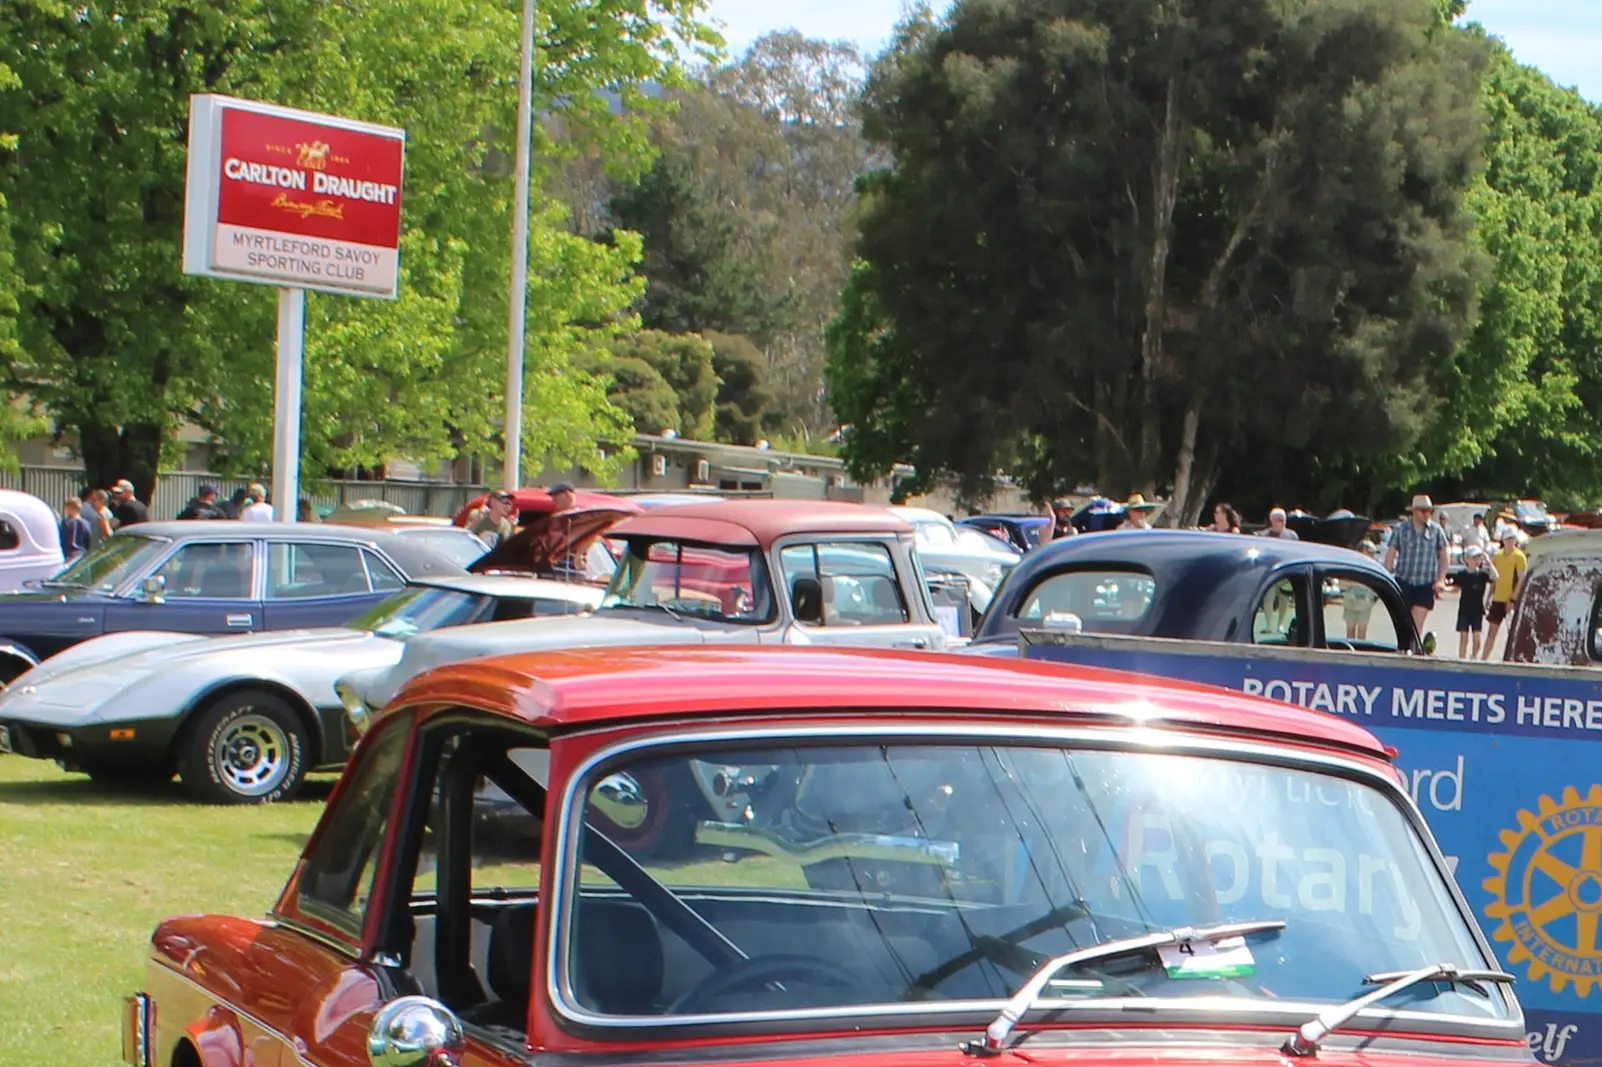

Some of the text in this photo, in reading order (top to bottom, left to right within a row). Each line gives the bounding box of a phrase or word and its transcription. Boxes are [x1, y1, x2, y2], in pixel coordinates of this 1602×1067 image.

[225, 157, 397, 205] CARLTON DRAUGHT
[233, 232, 381, 266] MYRTLEFORD SAVOY
[248, 252, 365, 281] SPORTING CLUB
[1391, 687, 1505, 724] MEETS
[1126, 812, 1460, 941] Rotary
[1526, 1023, 1578, 1061] elf
